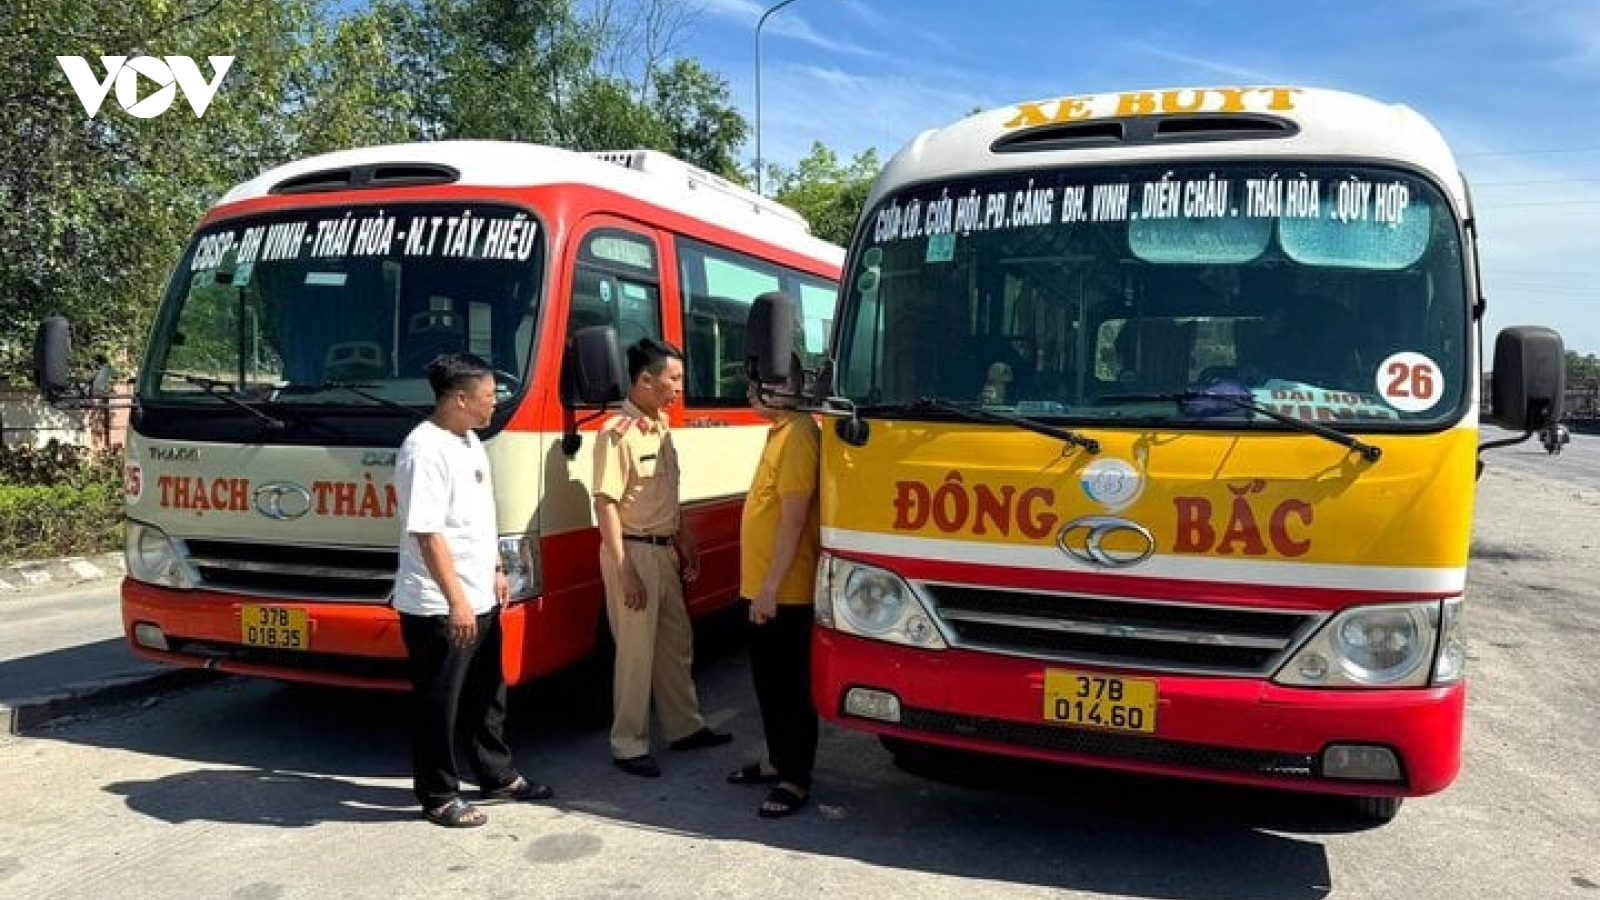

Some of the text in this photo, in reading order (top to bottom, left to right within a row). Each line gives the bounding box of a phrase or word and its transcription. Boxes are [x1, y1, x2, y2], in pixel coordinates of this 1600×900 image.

[1003, 96, 1095, 128] XE
[1246, 172, 1283, 218] THÁI
[1286, 171, 1320, 218] HÒA
[311, 210, 357, 257] THÁI
[442, 209, 485, 257] TÂY
[1386, 362, 1434, 400] 26
[157, 475, 250, 516] THẠCH
[893, 469, 1315, 557] ĐÔNG BẮC
[260, 607, 290, 627] 37B
[1076, 676, 1123, 702] 37B
[1055, 698, 1143, 729] 014.60
